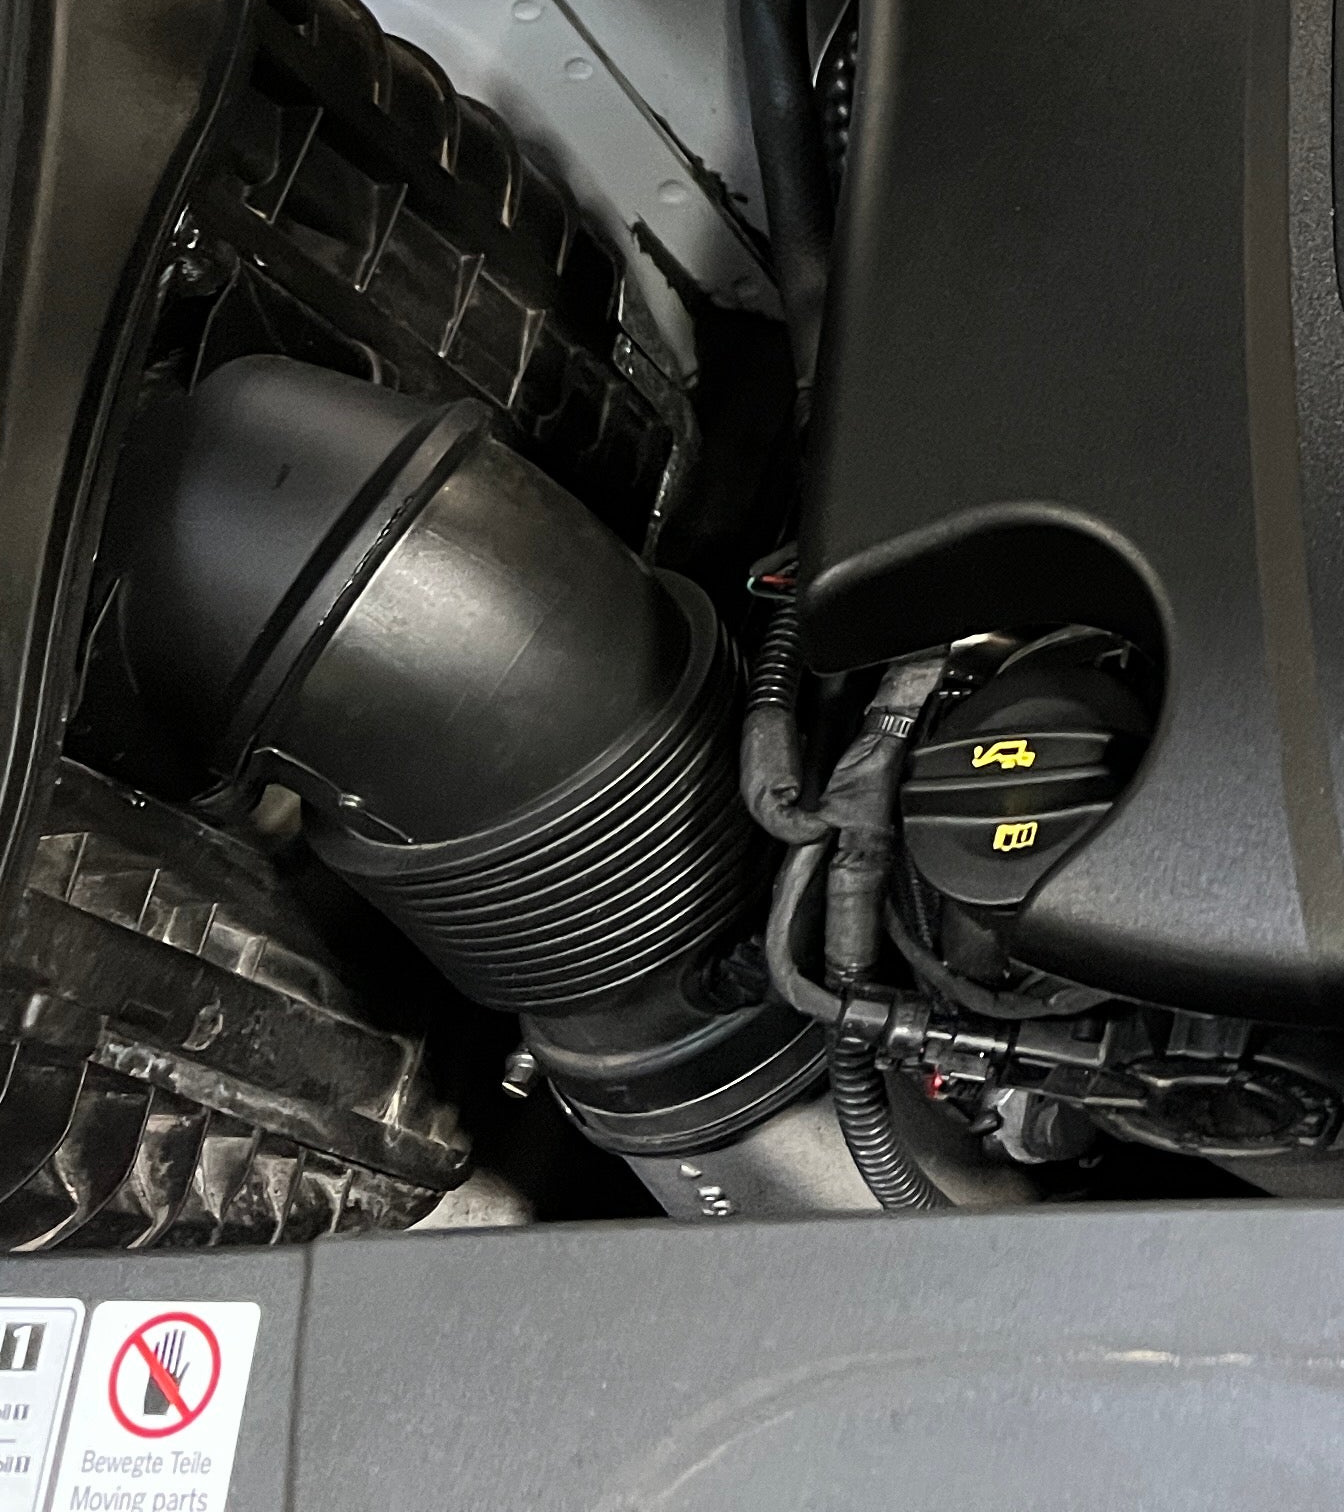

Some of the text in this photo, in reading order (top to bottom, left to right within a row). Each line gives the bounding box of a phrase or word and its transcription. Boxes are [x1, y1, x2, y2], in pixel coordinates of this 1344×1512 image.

[81, 1449, 212, 1478] Bewegte Teile
[70, 1485, 209, 1512] Moving parts
